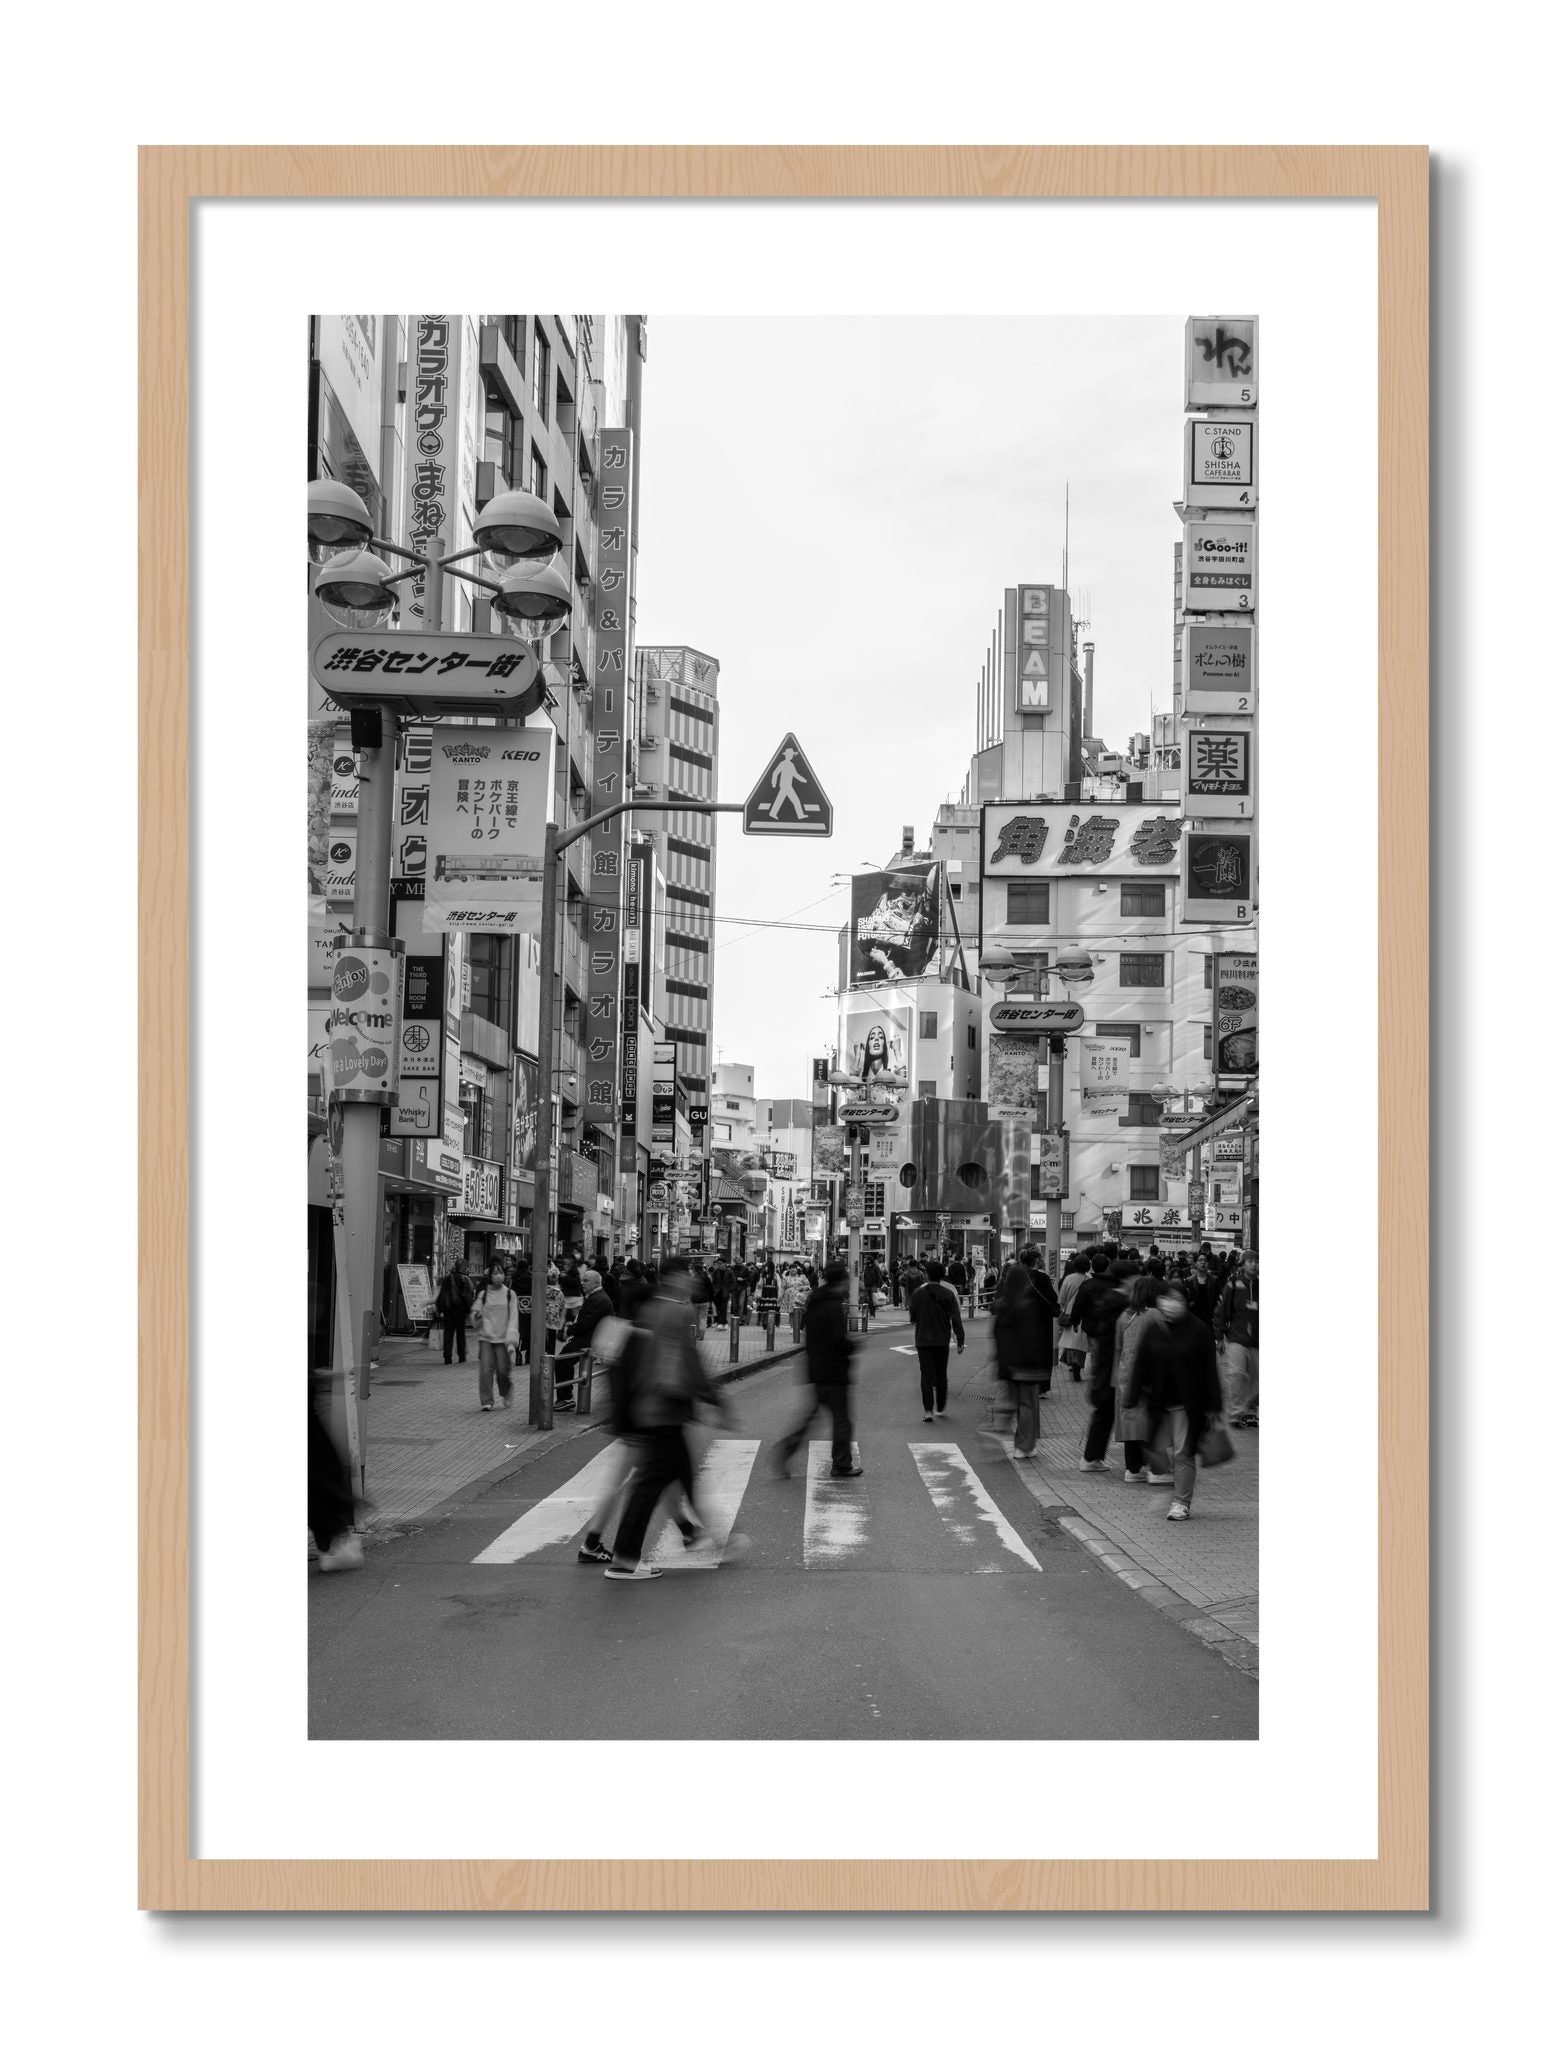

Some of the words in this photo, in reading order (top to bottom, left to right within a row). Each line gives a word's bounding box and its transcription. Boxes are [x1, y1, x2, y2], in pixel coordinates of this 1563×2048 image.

[415, 321, 449, 432] カラオケ
[1241, 389, 1251, 401] 5
[1205, 461, 1241, 469] SHISHA
[1240, 492, 1250, 504] 4
[1194, 576, 1248, 585] 全身もみほぐし
[1239, 595, 1248, 608] 3
[1022, 588, 1048, 706] BEAM
[323, 647, 525, 678] 渋谷センター街
[1239, 697, 1248, 710] 2
[501, 750, 540, 761] KEIO
[1197, 737, 1238, 778] 薬
[456, 780, 469, 814] 冒険へ
[334, 801, 354, 809] 渋谷店
[471, 780, 486, 839] カントーの
[505, 780, 519, 828] 京王線で
[1238, 801, 1244, 814] 1
[990, 815, 1184, 864] 角海老
[1193, 847, 1242, 886] 一蘭
[331, 888, 351, 896] 渋谷店
[446, 911, 518, 921] 渋谷センター街
[1237, 906, 1246, 918] B
[334, 967, 367, 996] Enjoy
[1220, 970, 1256, 980] 四川料理
[588, 908, 617, 1105] カラオケ館
[331, 1008, 393, 1028] Welcome
[996, 1009, 1079, 1019] 渋谷センター街
[345, 1056, 369, 1071] Lovely
[370, 1055, 387, 1067] Day!
[399, 1109, 427, 1117] Whisky
[691, 1111, 707, 1120] GU
